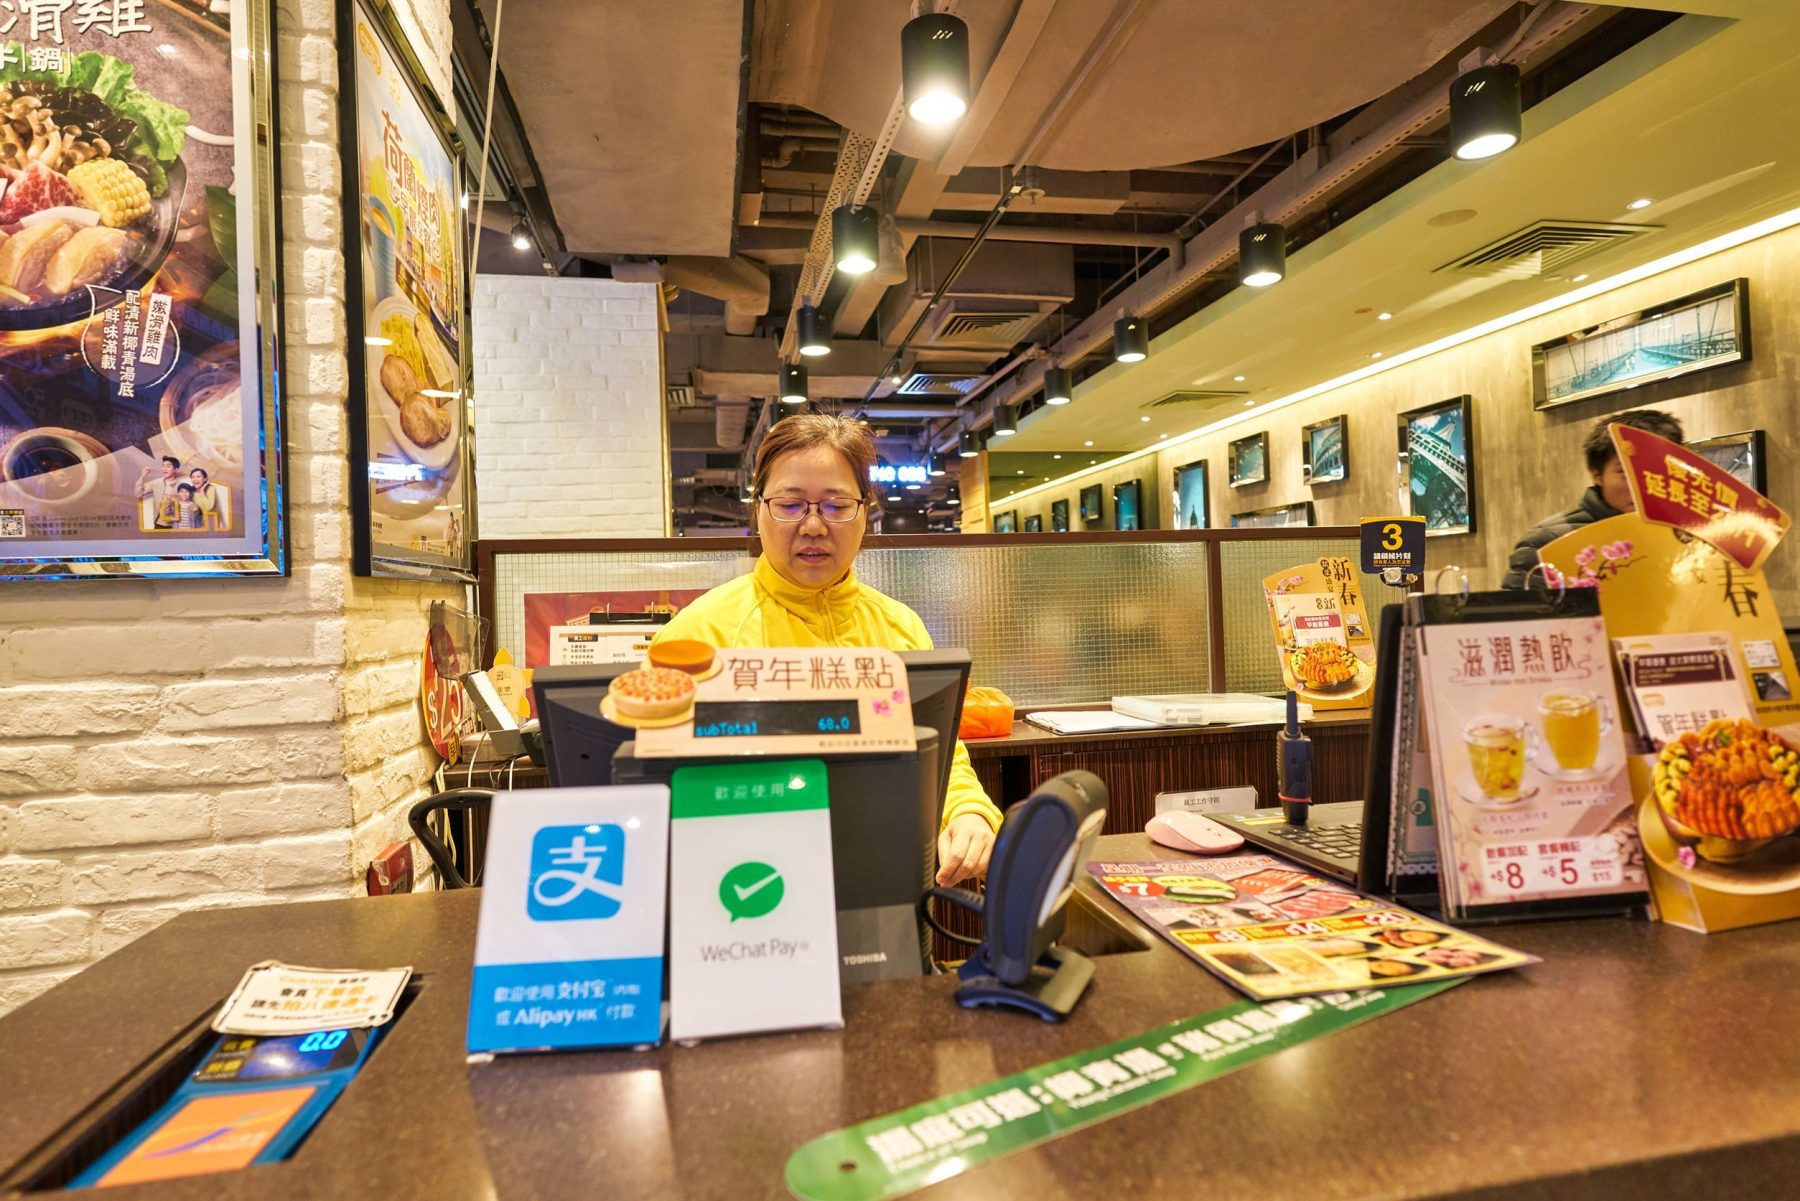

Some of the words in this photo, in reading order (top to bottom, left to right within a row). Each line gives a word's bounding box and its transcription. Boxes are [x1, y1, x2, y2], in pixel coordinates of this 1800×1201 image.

[101, 308, 120, 370] 鮮味滿載
[117, 289, 141, 398] 配清新椰青湯底
[142, 298, 169, 361] 嫩滑雞肉
[1381, 524, 1403, 550] 3
[1333, 558, 1357, 606] 新春
[1458, 633, 1575, 678] 滋潤熱飲
[728, 657, 894, 690] 賀年糕點
[695, 721, 758, 737] subTotal
[818, 716, 850, 731] 68.0
[715, 783, 785, 800] 歡迎使用
[701, 940, 767, 962] WeChat
[769, 937, 797, 960] Pay
[843, 952, 887, 966] TOSHIBA
[299, 1030, 348, 1052] 0.0
